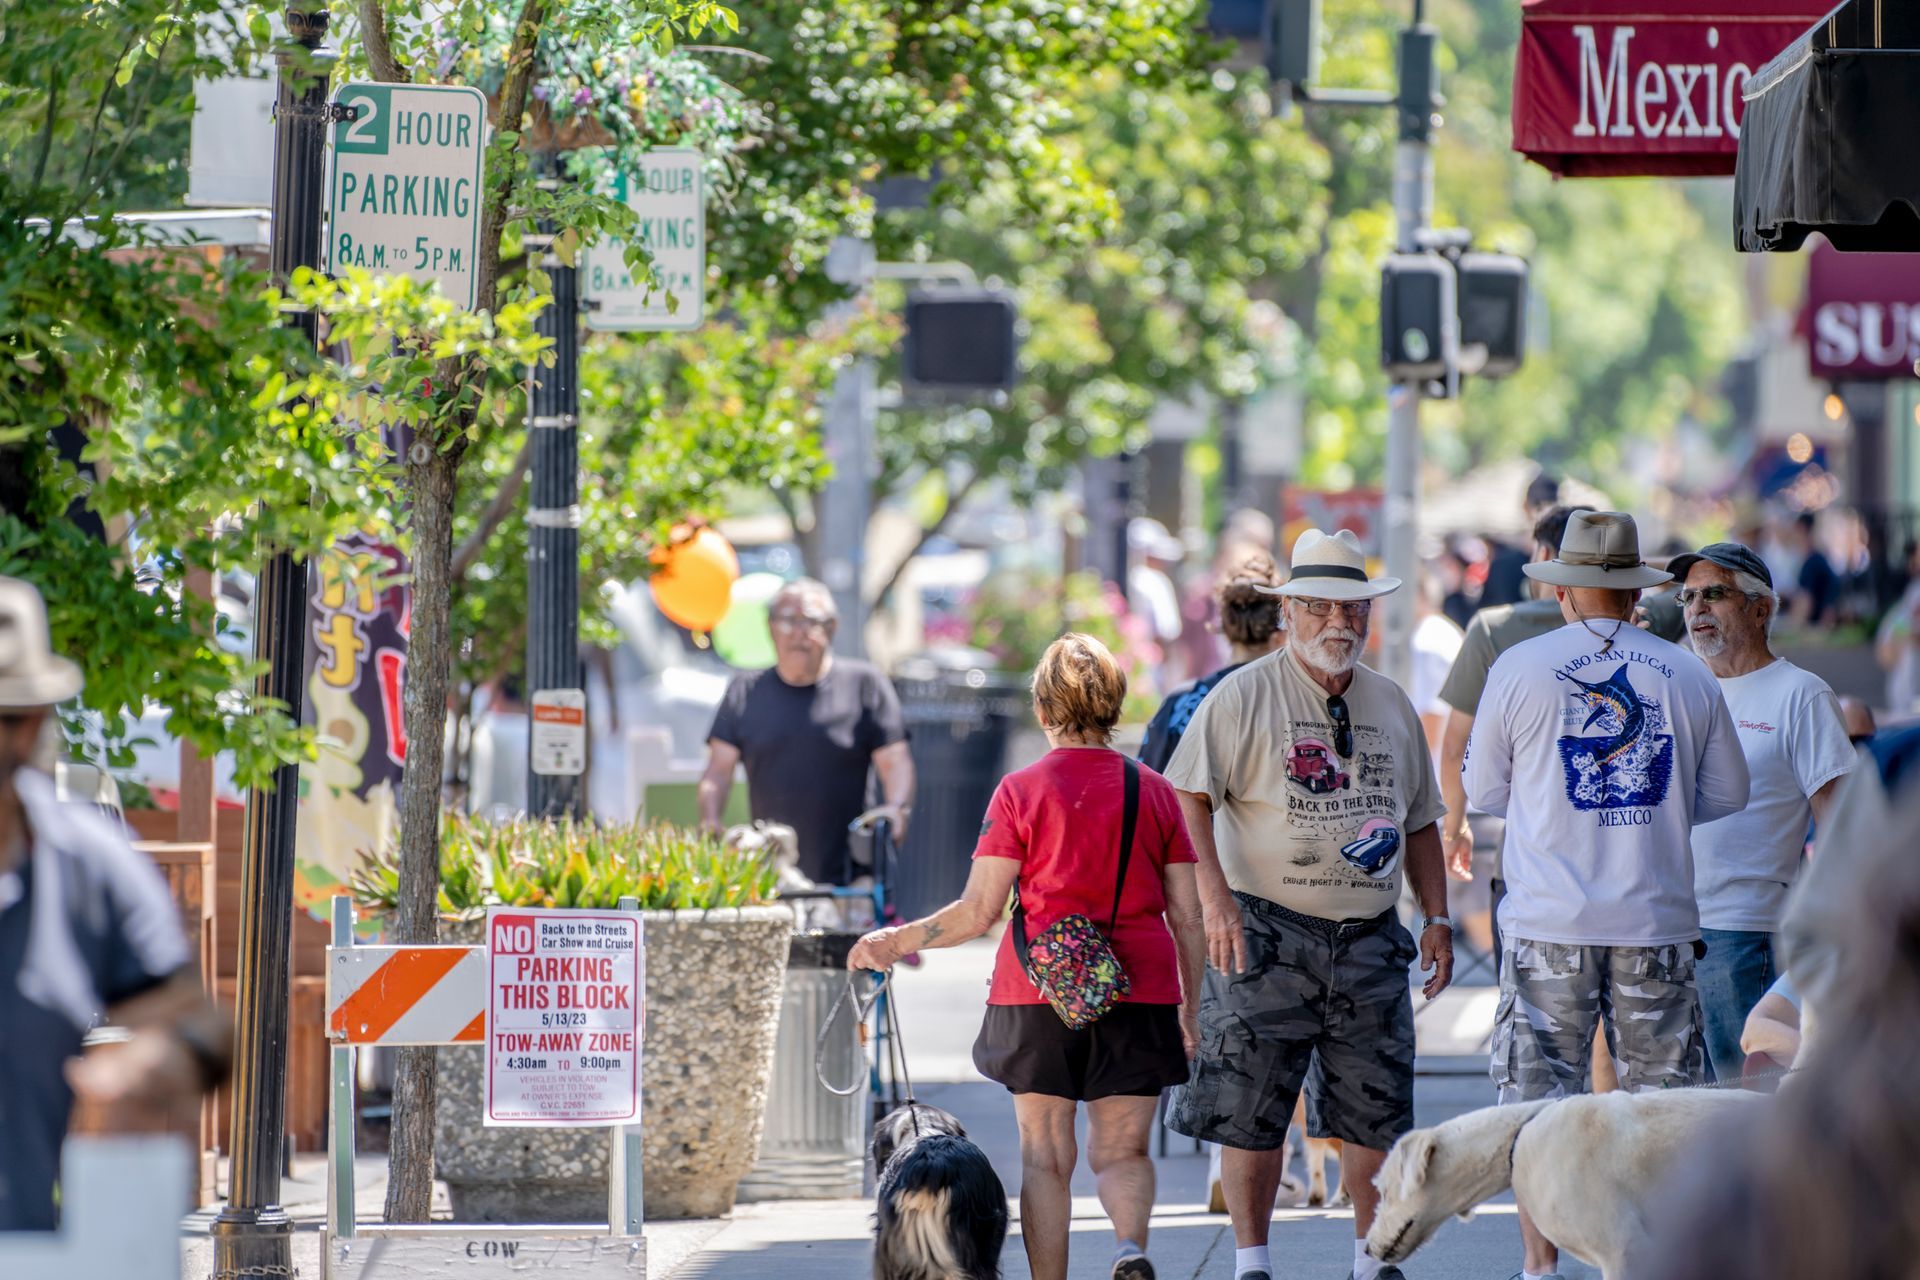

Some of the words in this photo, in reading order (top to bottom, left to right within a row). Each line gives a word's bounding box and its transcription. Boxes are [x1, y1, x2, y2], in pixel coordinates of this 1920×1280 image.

[345, 95, 378, 144] 2
[396, 111, 471, 148] HOUR
[340, 172, 470, 218] PARKING
[606, 216, 697, 250] KING
[393, 248, 408, 260] TO
[1555, 654, 1591, 681] CABO
[1593, 650, 1625, 663] SAN
[1629, 651, 1675, 679] LUCAS
[1560, 707, 1585, 716] GIANT
[1563, 717, 1584, 726] BLUE
[1288, 795, 1320, 813] BACK
[1324, 800, 1339, 812] TO
[1343, 796, 1363, 810] THE
[1598, 809, 1652, 827] MEXICO
[1282, 876, 1307, 886] CRUISE
[1309, 879, 1333, 887] NIGHT
[495, 924, 532, 953] NO
[542, 923, 563, 935] Back
[567, 924, 576, 935] to
[578, 924, 592, 935] the
[595, 924, 627, 936] Streets
[542, 937, 558, 948] Car
[560, 938, 584, 948] Show
[586, 938, 602, 948] and
[605, 938, 634, 949] Cruise
[517, 957, 613, 982] PARKING
[500, 985, 550, 1010] THIS
[557, 985, 629, 1010] BLOCK
[542, 1012, 587, 1028] 5/13/23
[495, 1033, 584, 1052] TOW-AWAY
[588, 1033, 632, 1052] ZONE
[507, 1057, 547, 1069] 4:30am
[557, 1060, 571, 1070] TO
[580, 1056, 621, 1071] 9:00pm
[519, 1075, 558, 1083] VEHICLES
[558, 1075, 567, 1083] IN
[568, 1075, 608, 1083] VIOLATION
[531, 1083, 565, 1092] SUBJECT
[567, 1083, 578, 1092] TO
[521, 1092, 530, 1100] AT
[465, 1241, 520, 1259] COW
